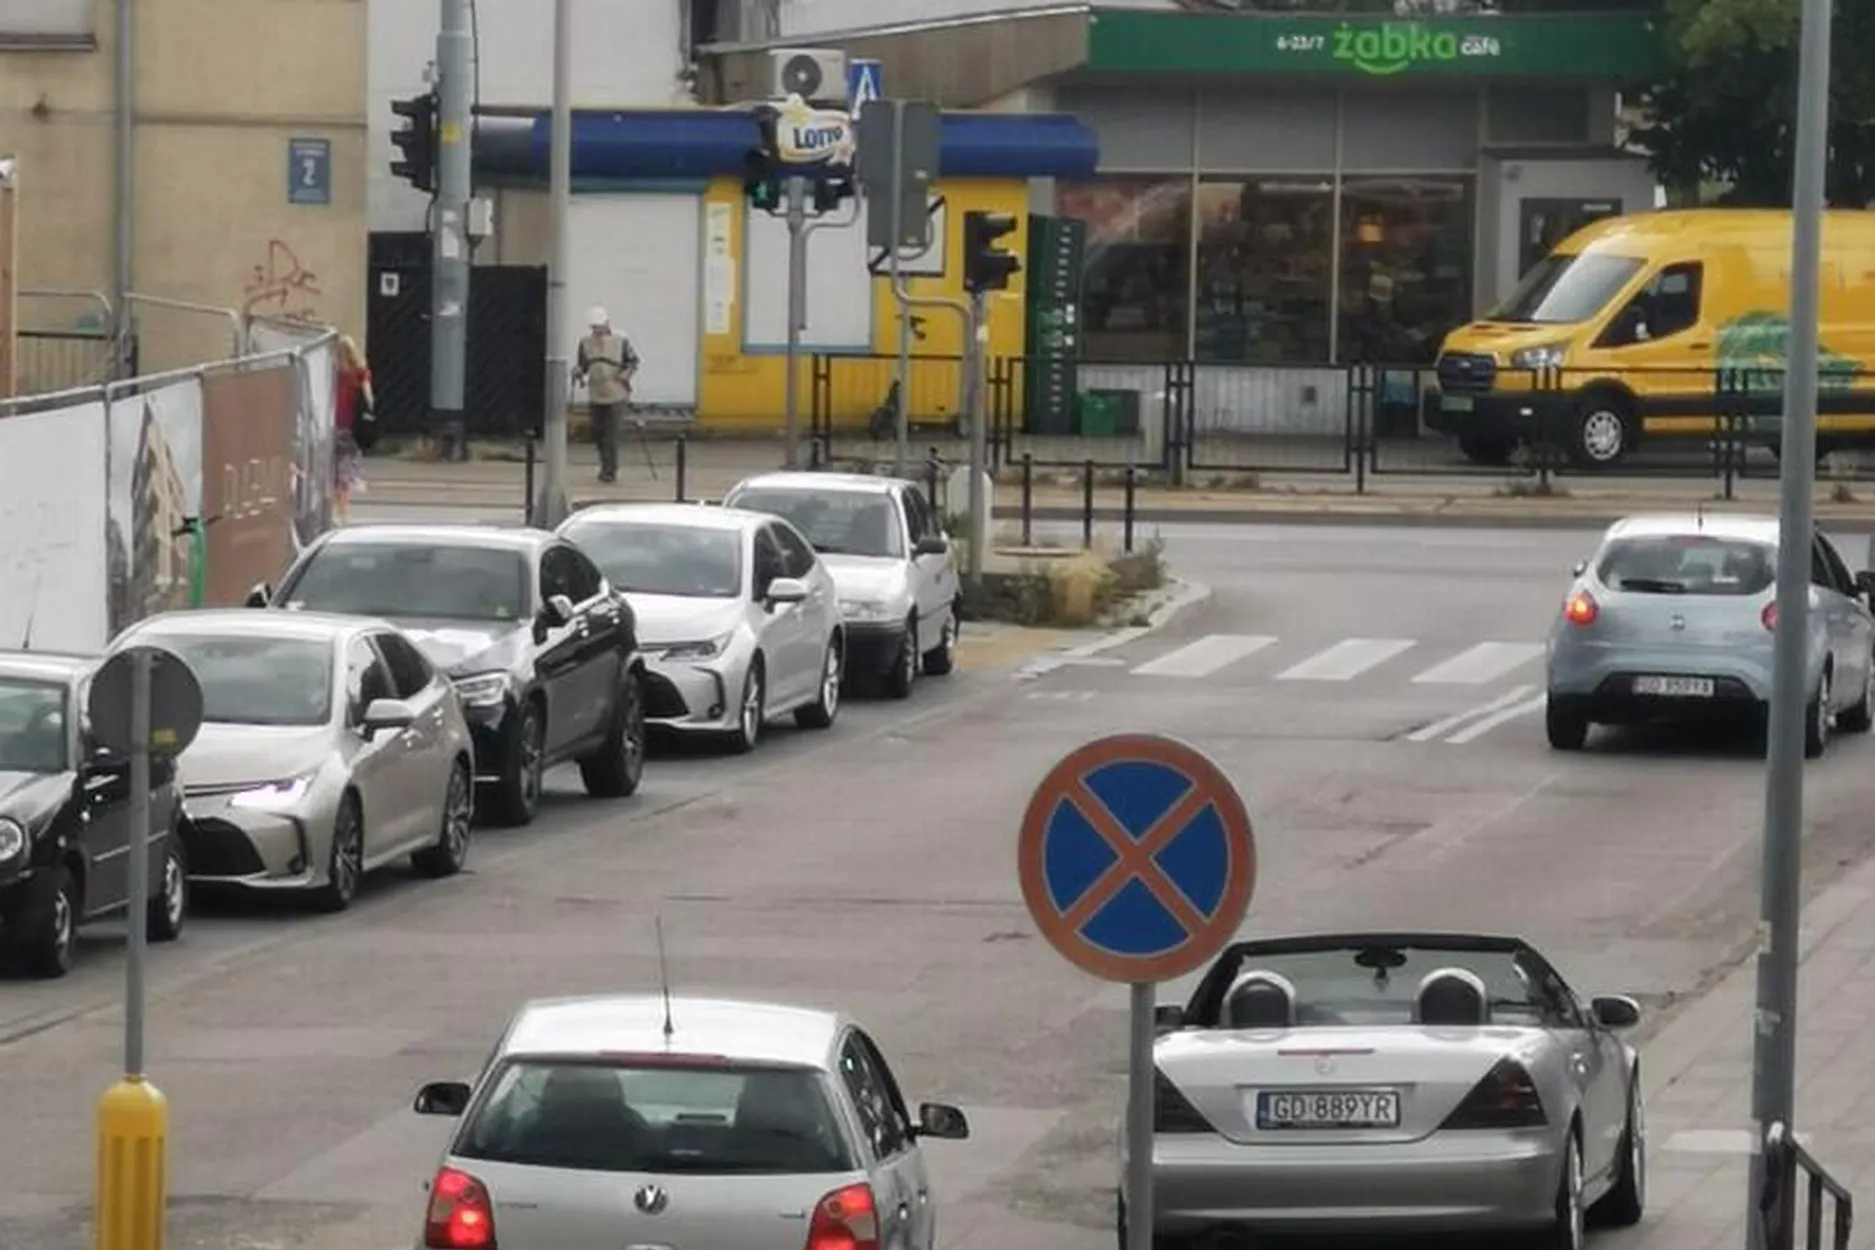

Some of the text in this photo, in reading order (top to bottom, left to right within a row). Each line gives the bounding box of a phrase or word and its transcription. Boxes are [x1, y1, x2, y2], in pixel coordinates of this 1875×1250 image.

[1333, 21, 1458, 60] żabka
[793, 126, 844, 150] LOTTO
[1274, 1096, 1391, 1119] GD 889YR
